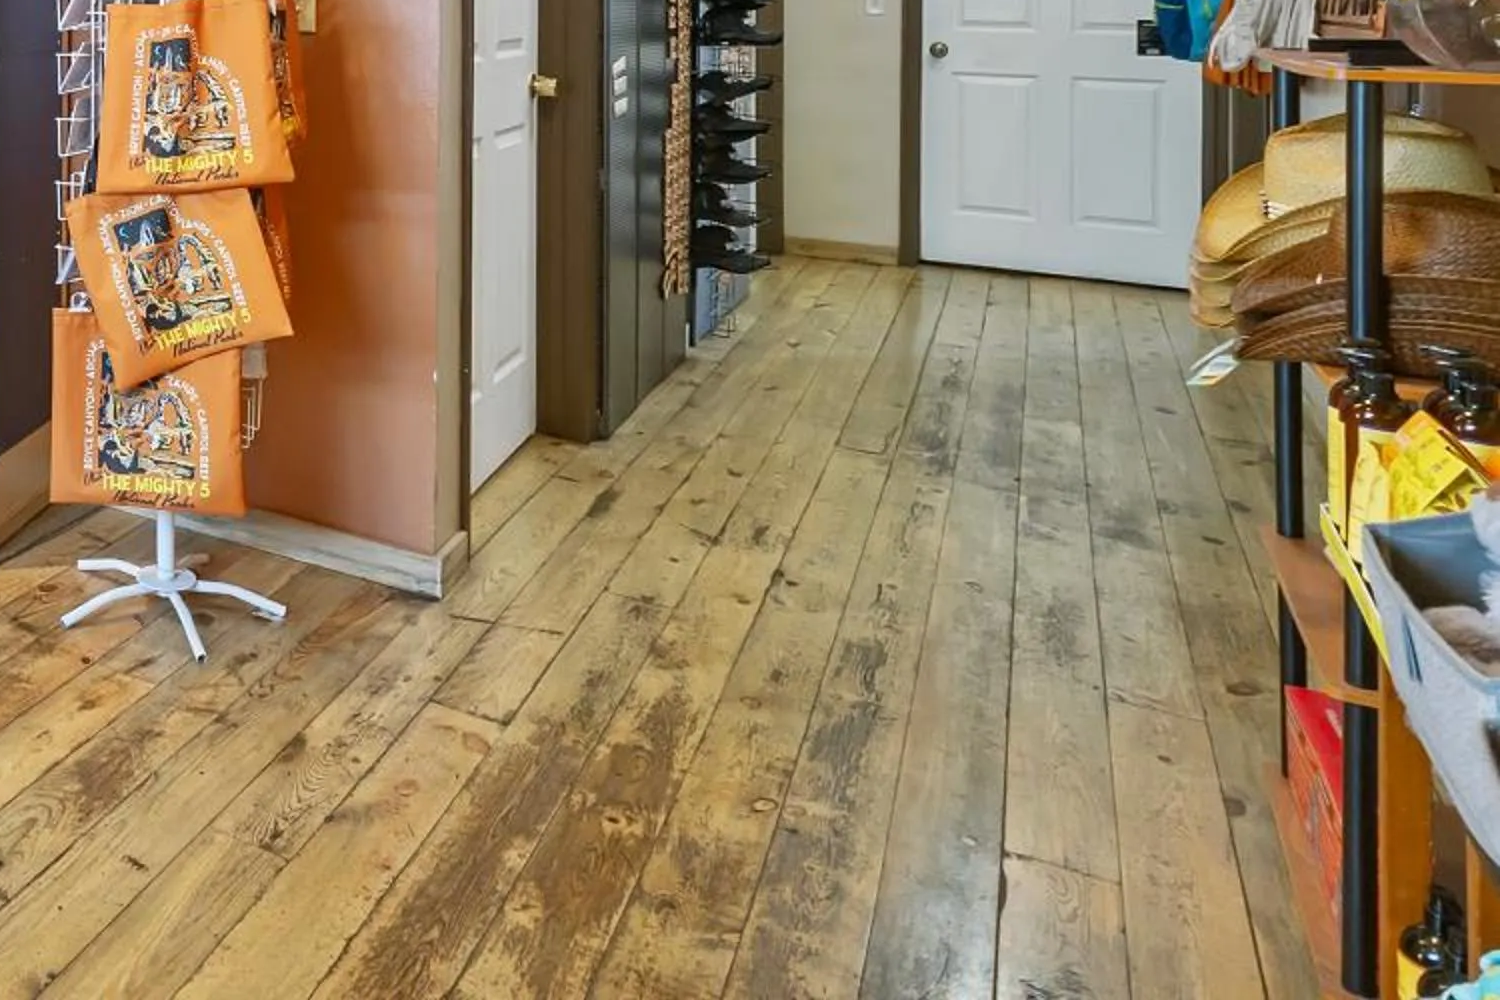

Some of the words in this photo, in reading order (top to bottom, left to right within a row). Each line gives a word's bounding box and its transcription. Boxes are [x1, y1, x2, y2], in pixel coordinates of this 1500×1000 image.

[145, 156, 173, 174] THE
[177, 150, 237, 172] MIGHTY
[243, 148, 254, 164] 5
[155, 168, 206, 186] National
[154, 328, 185, 351] THE
[184, 312, 238, 338] MIGHTY
[240, 308, 252, 324] 5
[84, 387, 95, 435] CANYON
[102, 473, 132, 490] THE
[134, 475, 197, 498] MIGHTY
[199, 482, 211, 498] 5
